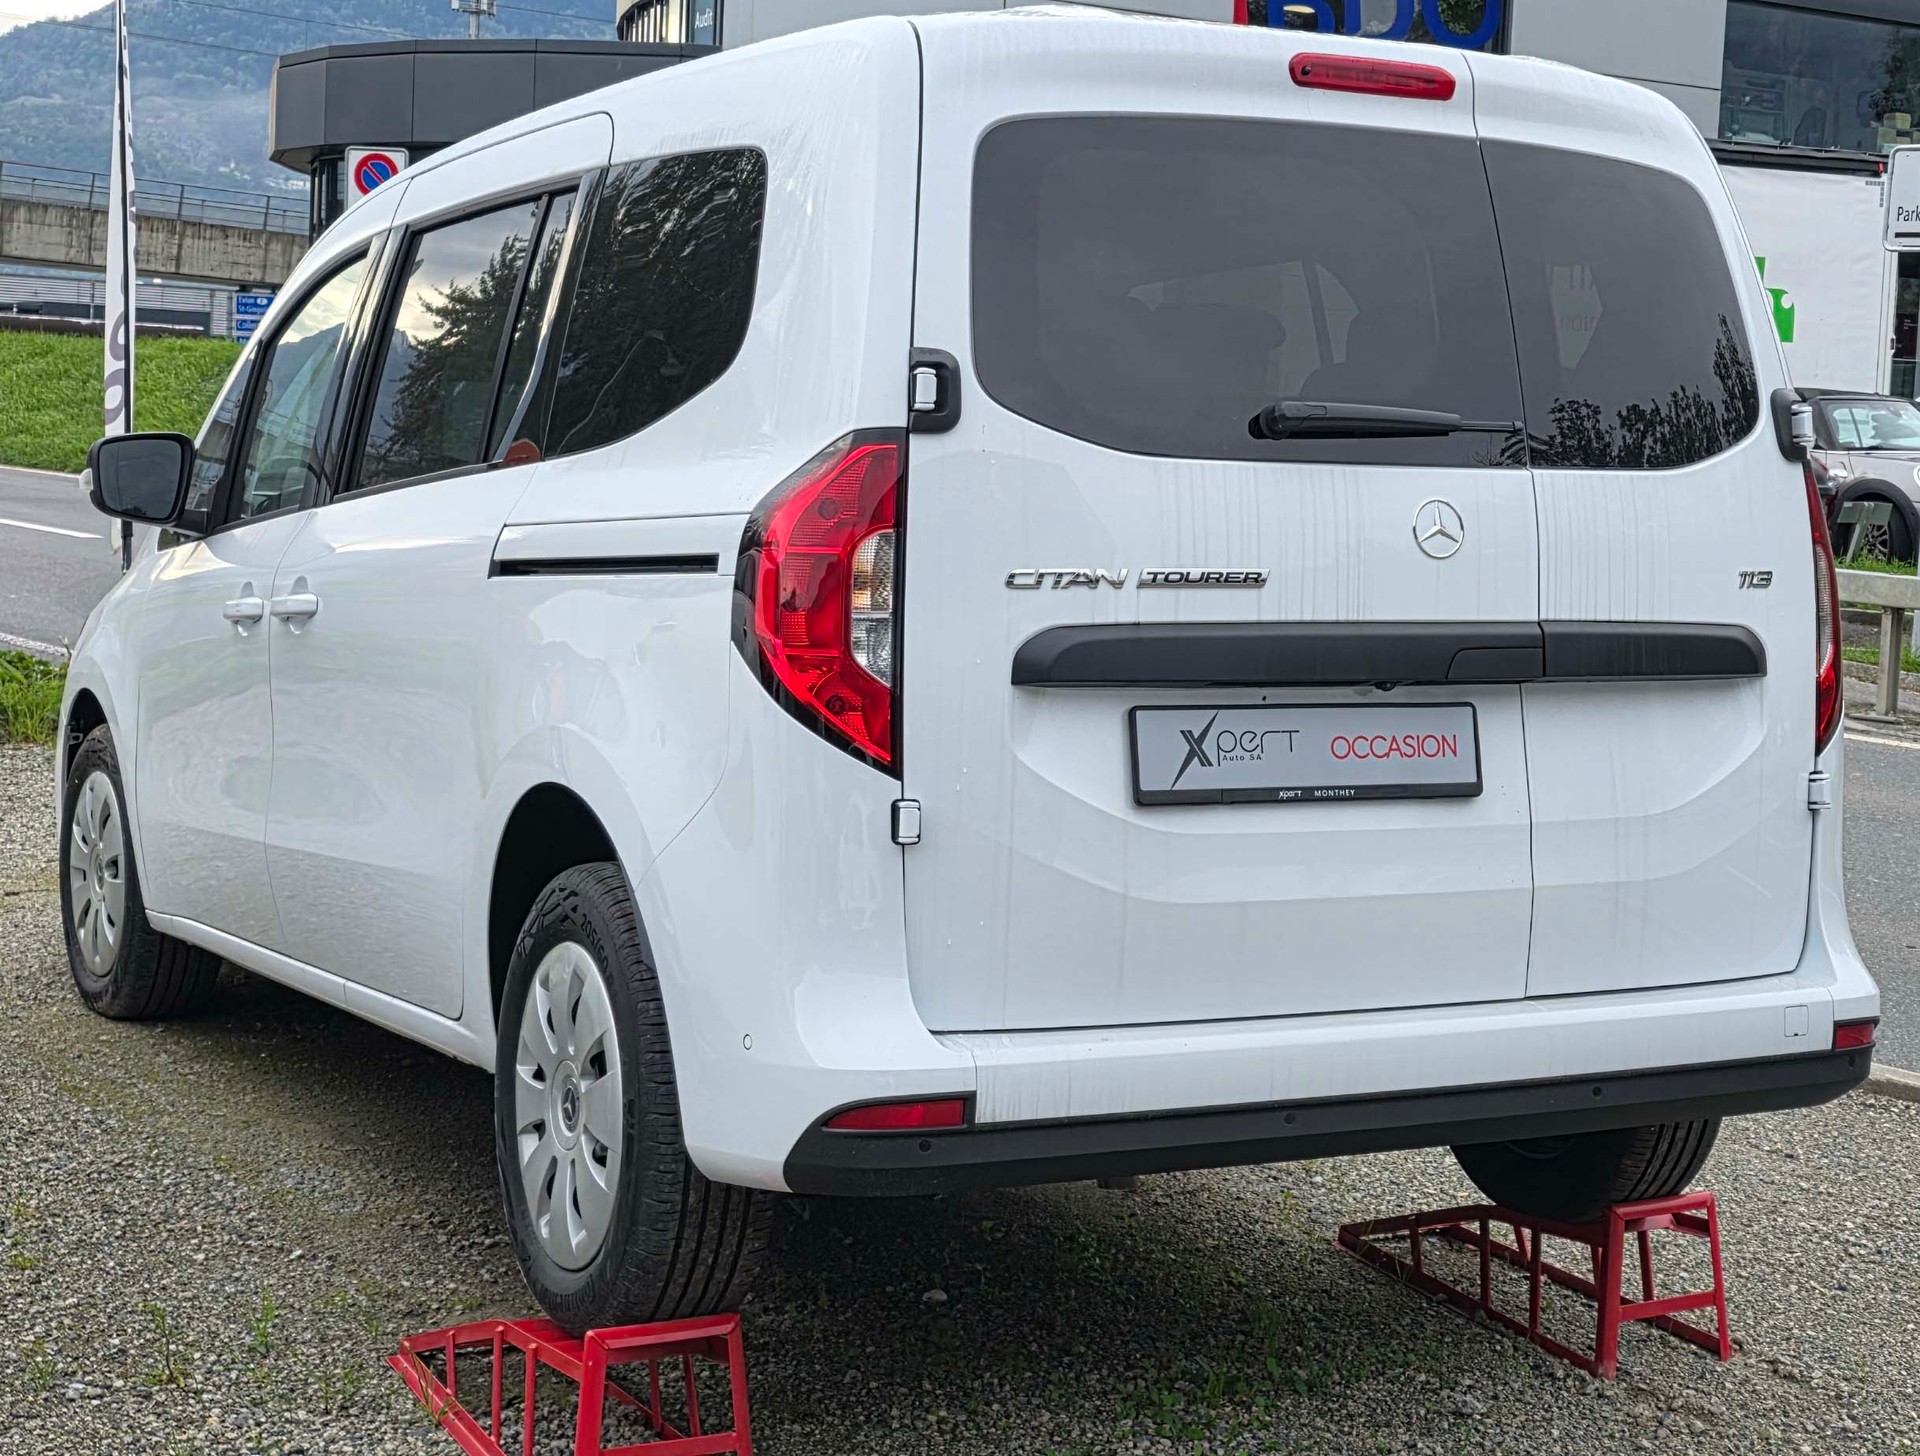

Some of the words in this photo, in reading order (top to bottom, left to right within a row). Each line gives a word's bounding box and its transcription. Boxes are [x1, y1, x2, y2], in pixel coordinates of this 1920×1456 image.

[695, 8, 713, 29] Audit
[1004, 568, 1130, 589] CITAN
[1146, 570, 1265, 585] TOURER
[1738, 570, 1773, 589] 113
[1249, 753, 1262, 761] SA
[1330, 734, 1458, 760] OCCASION
[1314, 789, 1355, 797] MONTHEY
